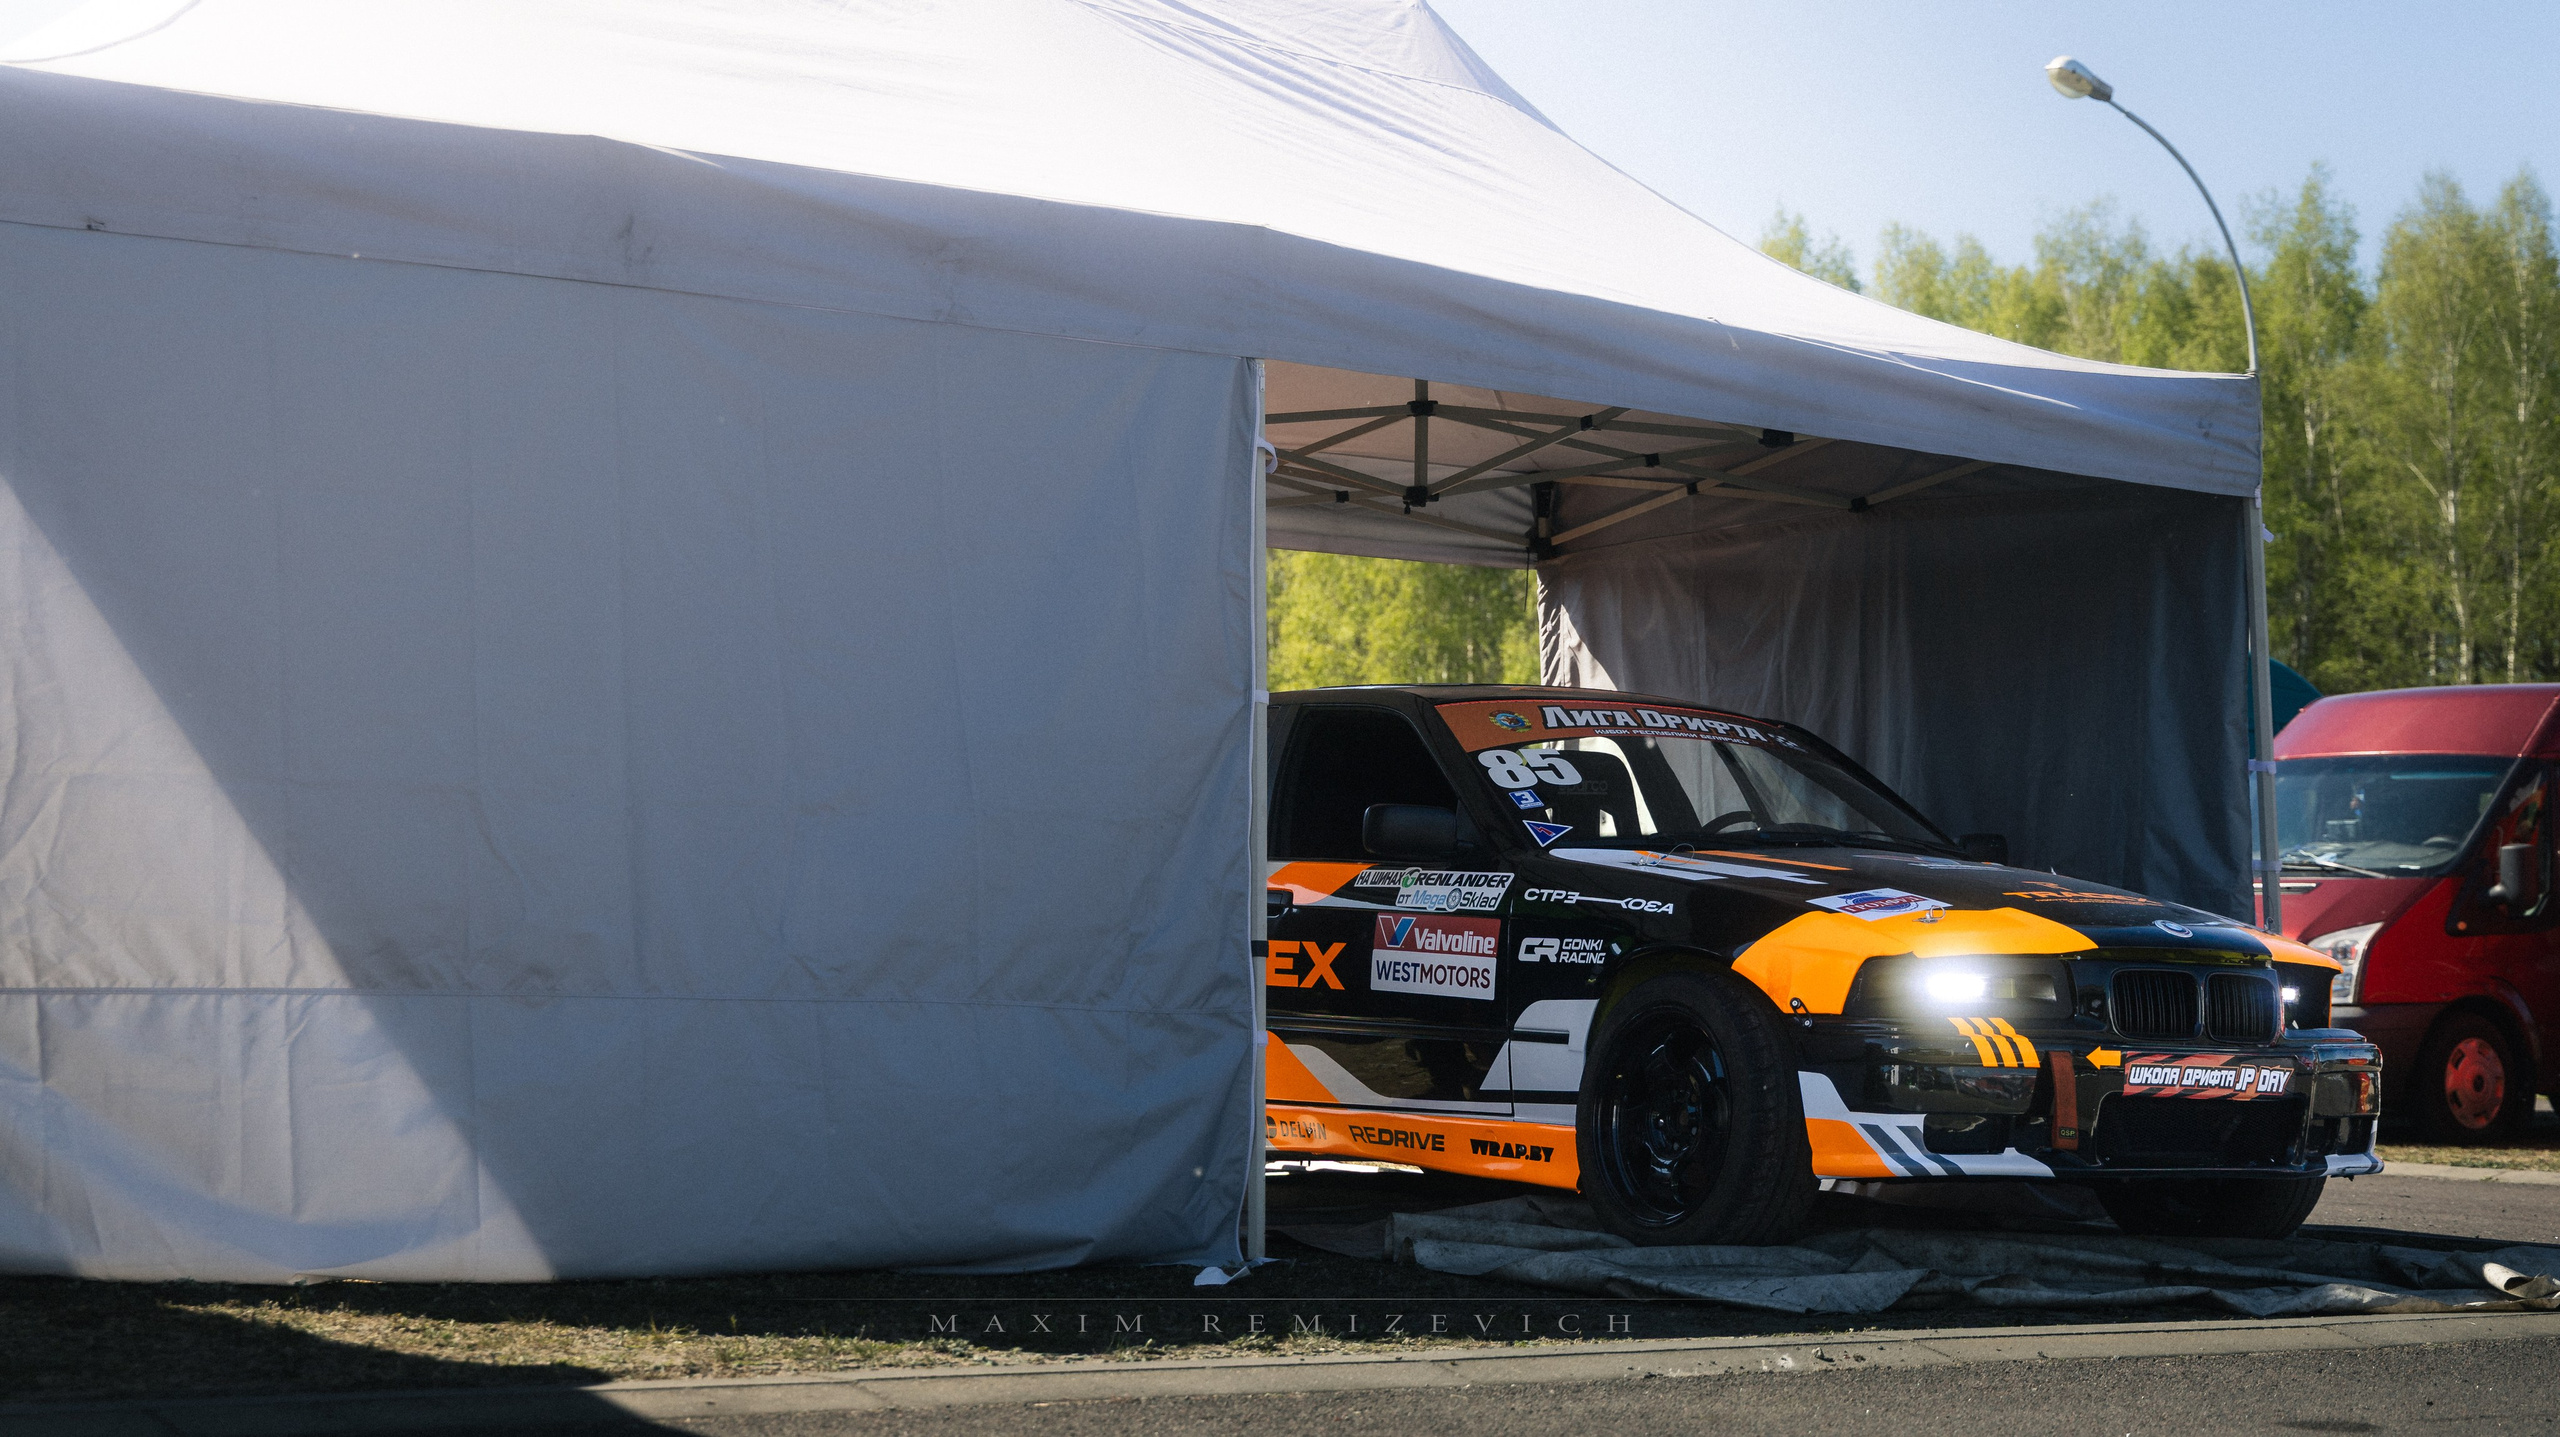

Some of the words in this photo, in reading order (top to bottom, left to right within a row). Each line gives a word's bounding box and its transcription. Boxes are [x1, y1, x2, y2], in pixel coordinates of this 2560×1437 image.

[1478, 749, 1582, 788] 85
[1414, 927, 1496, 954] Valvoline
[1562, 938, 1603, 951] GONKI
[1560, 952, 1606, 964] RACING
[1376, 960, 1490, 989] WESTMOTORS
[2129, 1066, 2180, 1086] ШКОЛА
[2181, 1068, 2236, 1089] ДРИФТА
[2235, 1066, 2257, 1092] JP
[2256, 1069, 2290, 1093] DAY
[1348, 1124, 1445, 1152] REDRIVE
[1470, 1138, 1554, 1163] WRAP.BY
